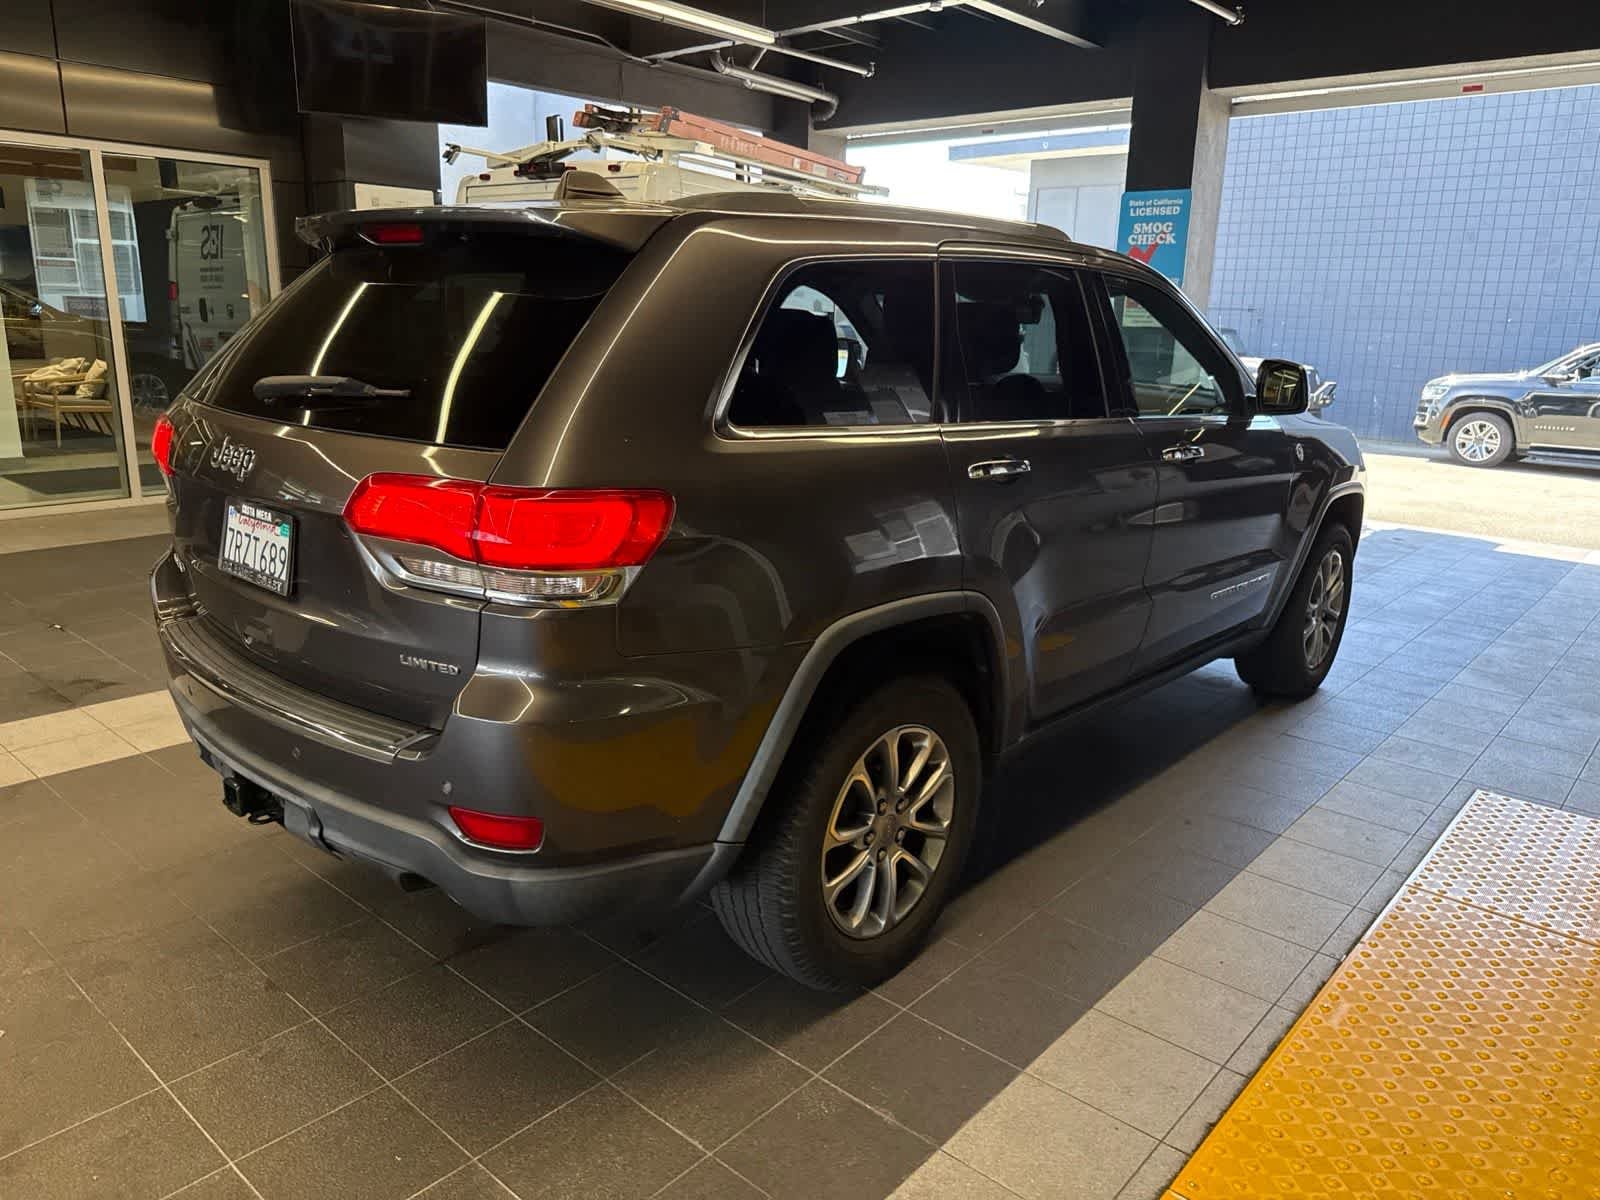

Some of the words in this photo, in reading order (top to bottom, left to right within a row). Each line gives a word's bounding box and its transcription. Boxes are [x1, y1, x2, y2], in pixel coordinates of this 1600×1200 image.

[1130, 206, 1181, 217] LICENSED
[1133, 222, 1173, 234] SMOG
[1127, 232, 1177, 246] CHECK
[210, 436, 256, 482] Jeep
[256, 508, 272, 522] MESA
[226, 527, 287, 580] 7RZT689
[399, 654, 459, 676] LIMITED
